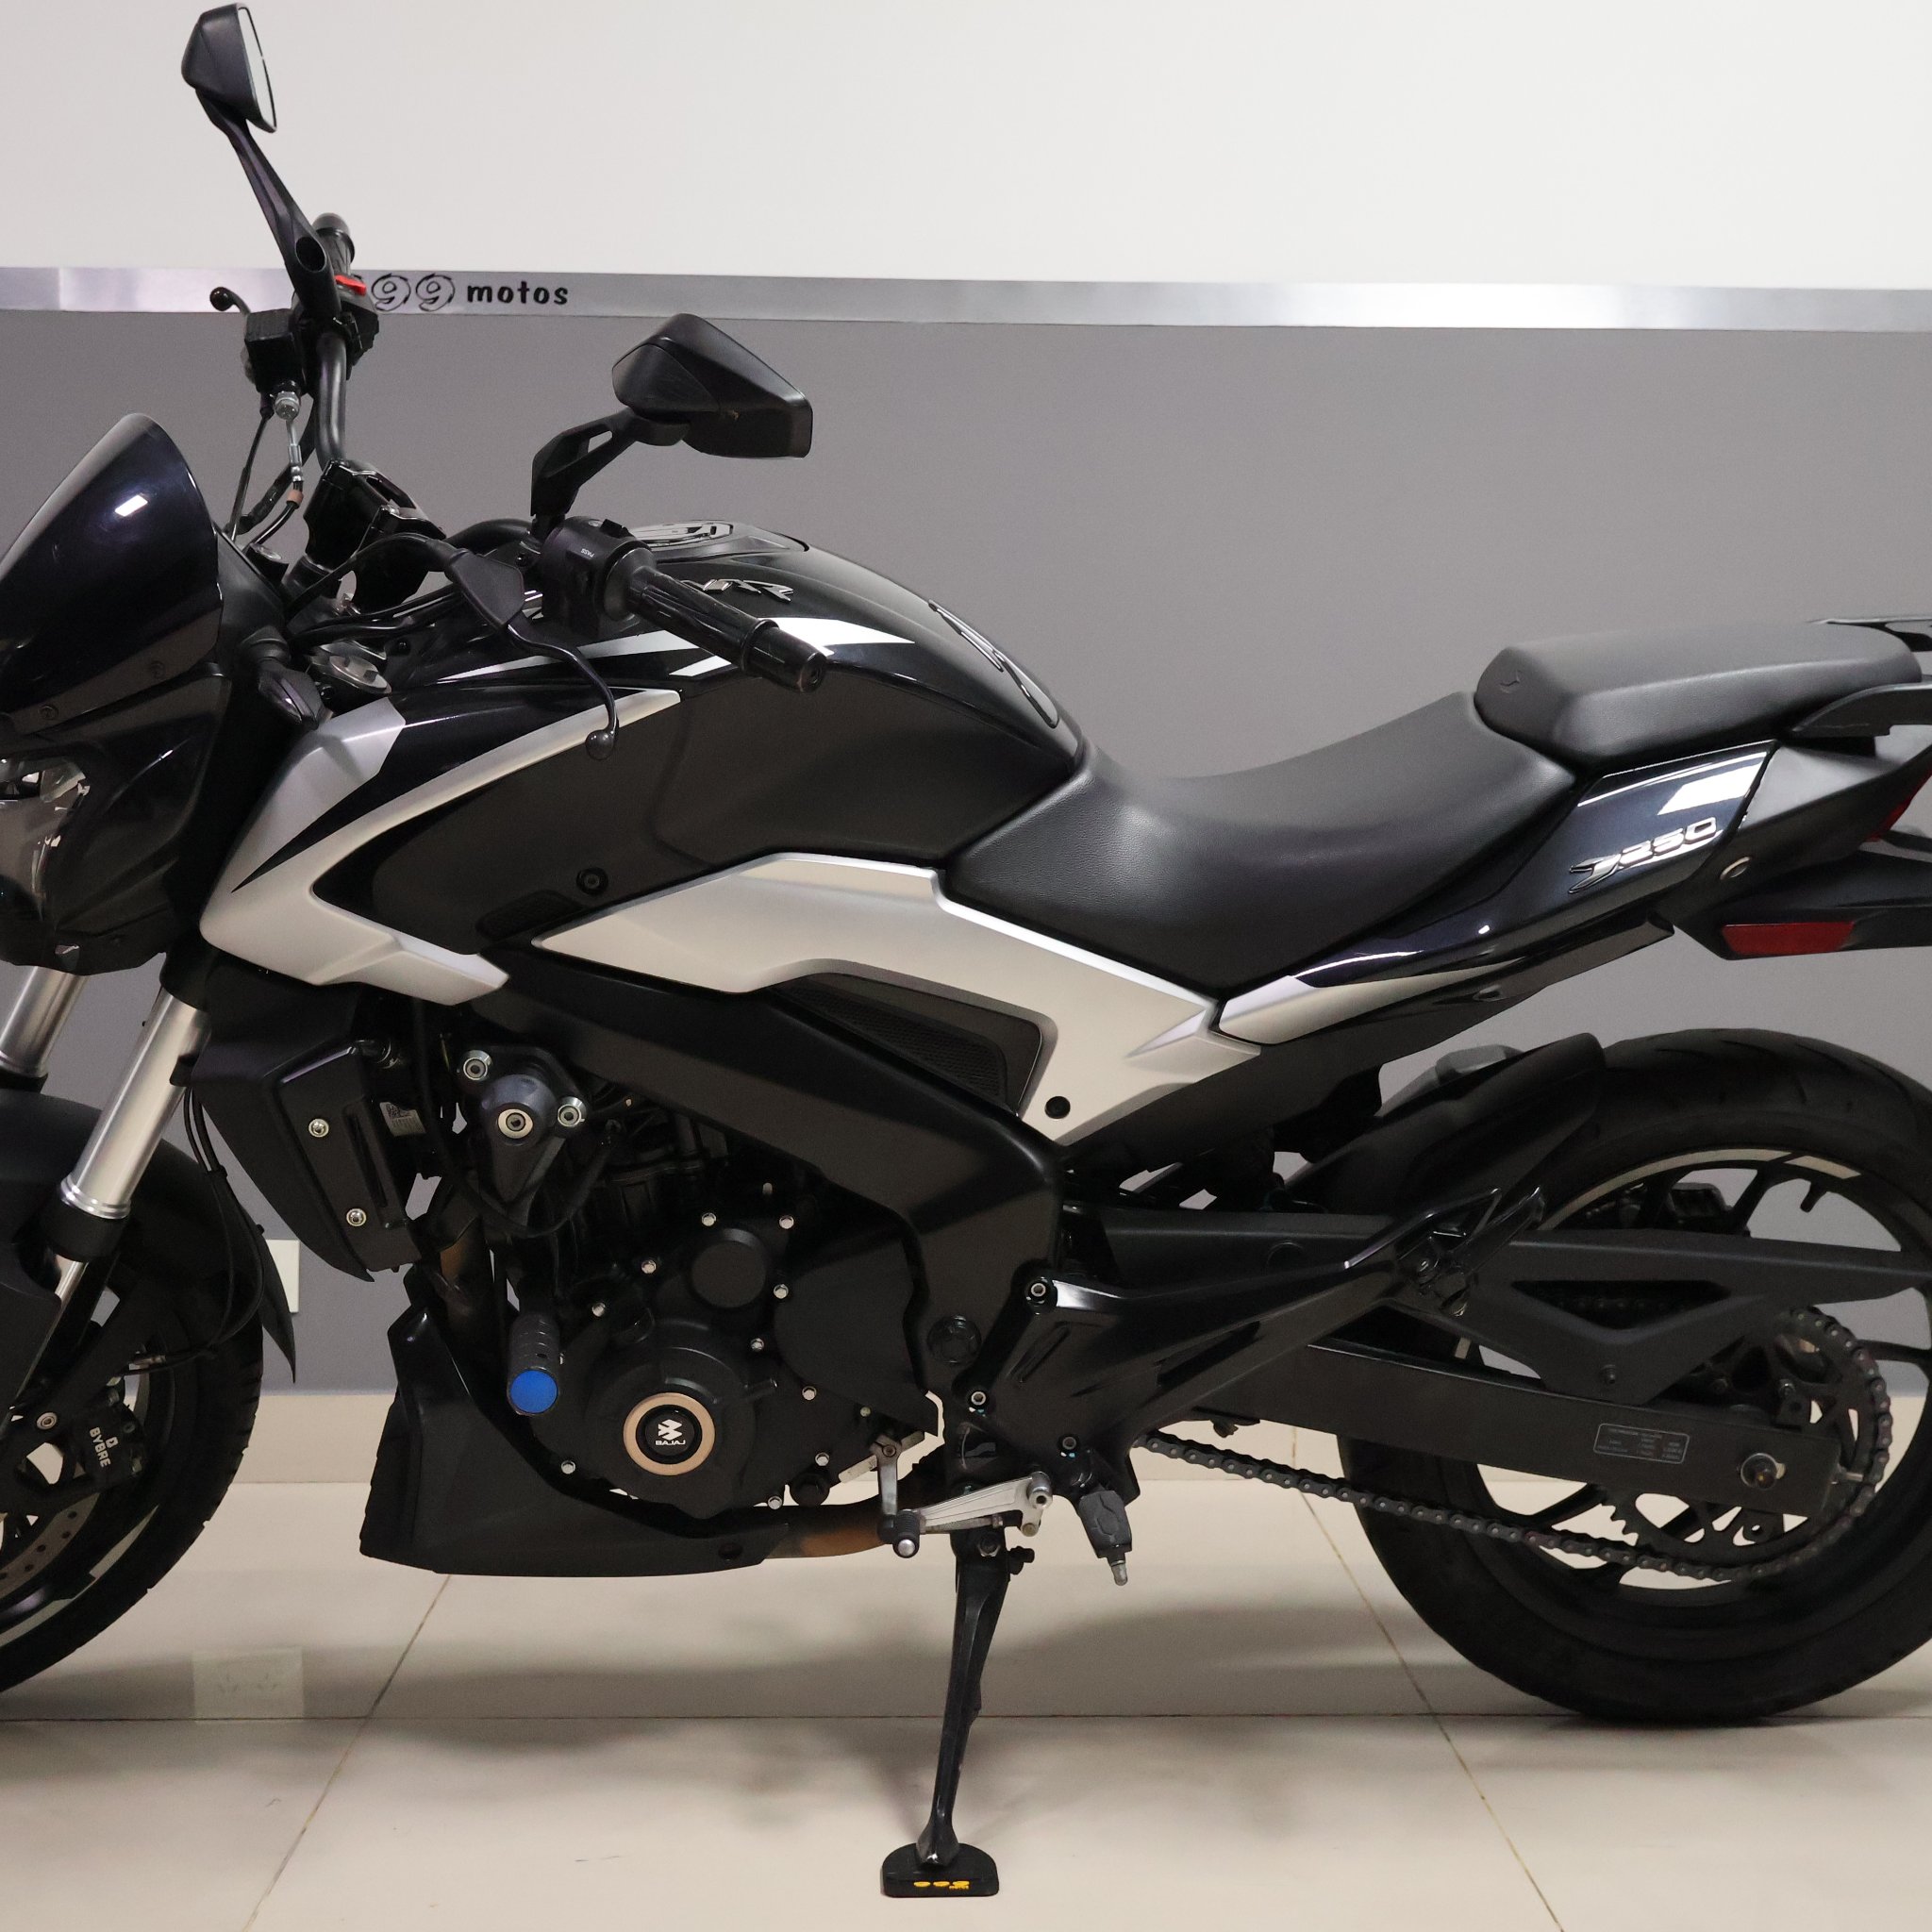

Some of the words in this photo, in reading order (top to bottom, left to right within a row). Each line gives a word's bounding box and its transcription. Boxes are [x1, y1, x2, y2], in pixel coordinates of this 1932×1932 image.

[354, 273, 456, 311] 99
[467, 280, 568, 305] motos
[89, 1426, 111, 1468] BYBRE
